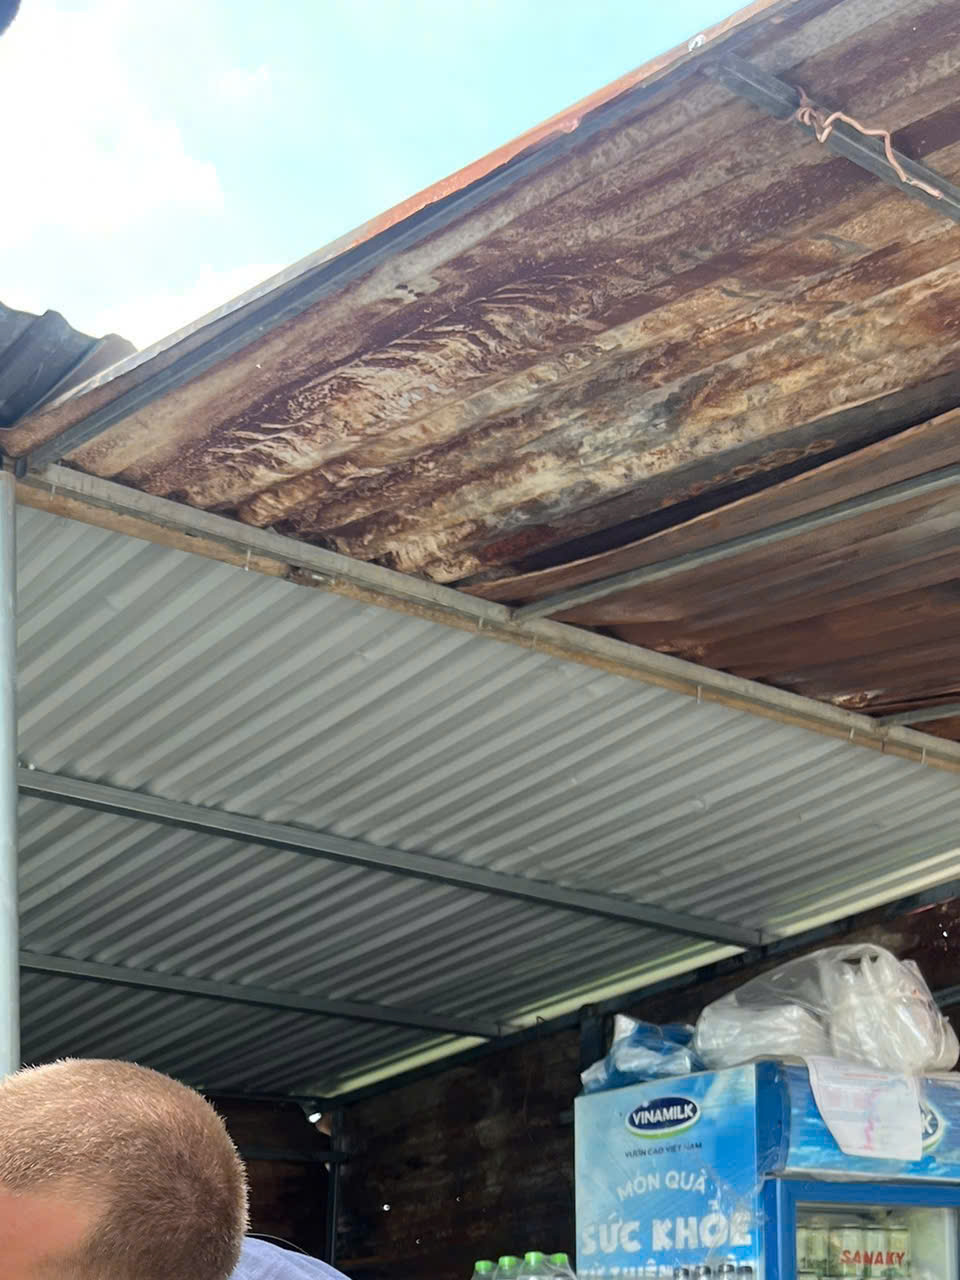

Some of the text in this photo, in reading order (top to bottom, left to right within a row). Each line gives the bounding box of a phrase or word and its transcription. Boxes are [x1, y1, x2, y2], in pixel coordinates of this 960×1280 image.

[632, 1103, 695, 1126] VINAMILK
[581, 1212, 642, 1256] SỨC
[839, 1249, 906, 1266] SANAKY
